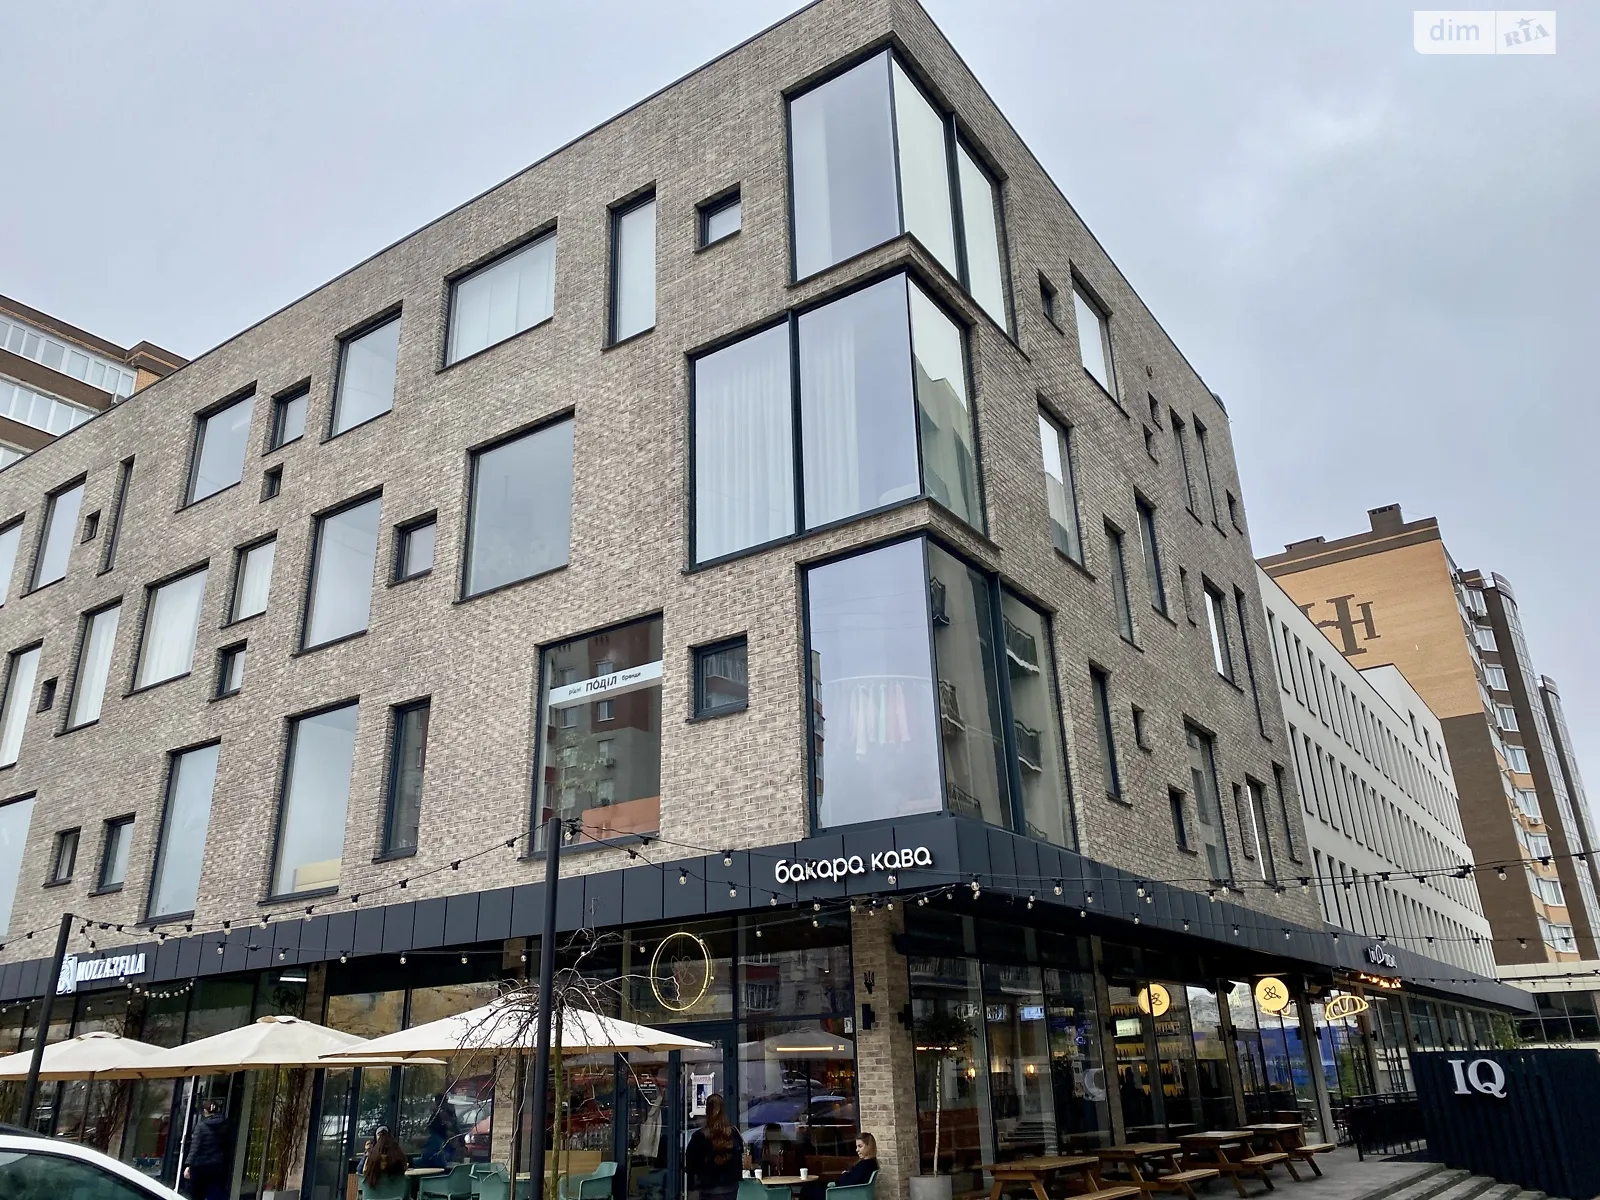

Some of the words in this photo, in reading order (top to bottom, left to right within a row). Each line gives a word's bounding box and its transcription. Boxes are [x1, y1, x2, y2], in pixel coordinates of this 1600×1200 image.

[775, 855, 865, 884] бакара
[871, 846, 932, 871] кава
[76, 953, 146, 982] MOZZARELLA
[1448, 1058, 1507, 1099] IQ
